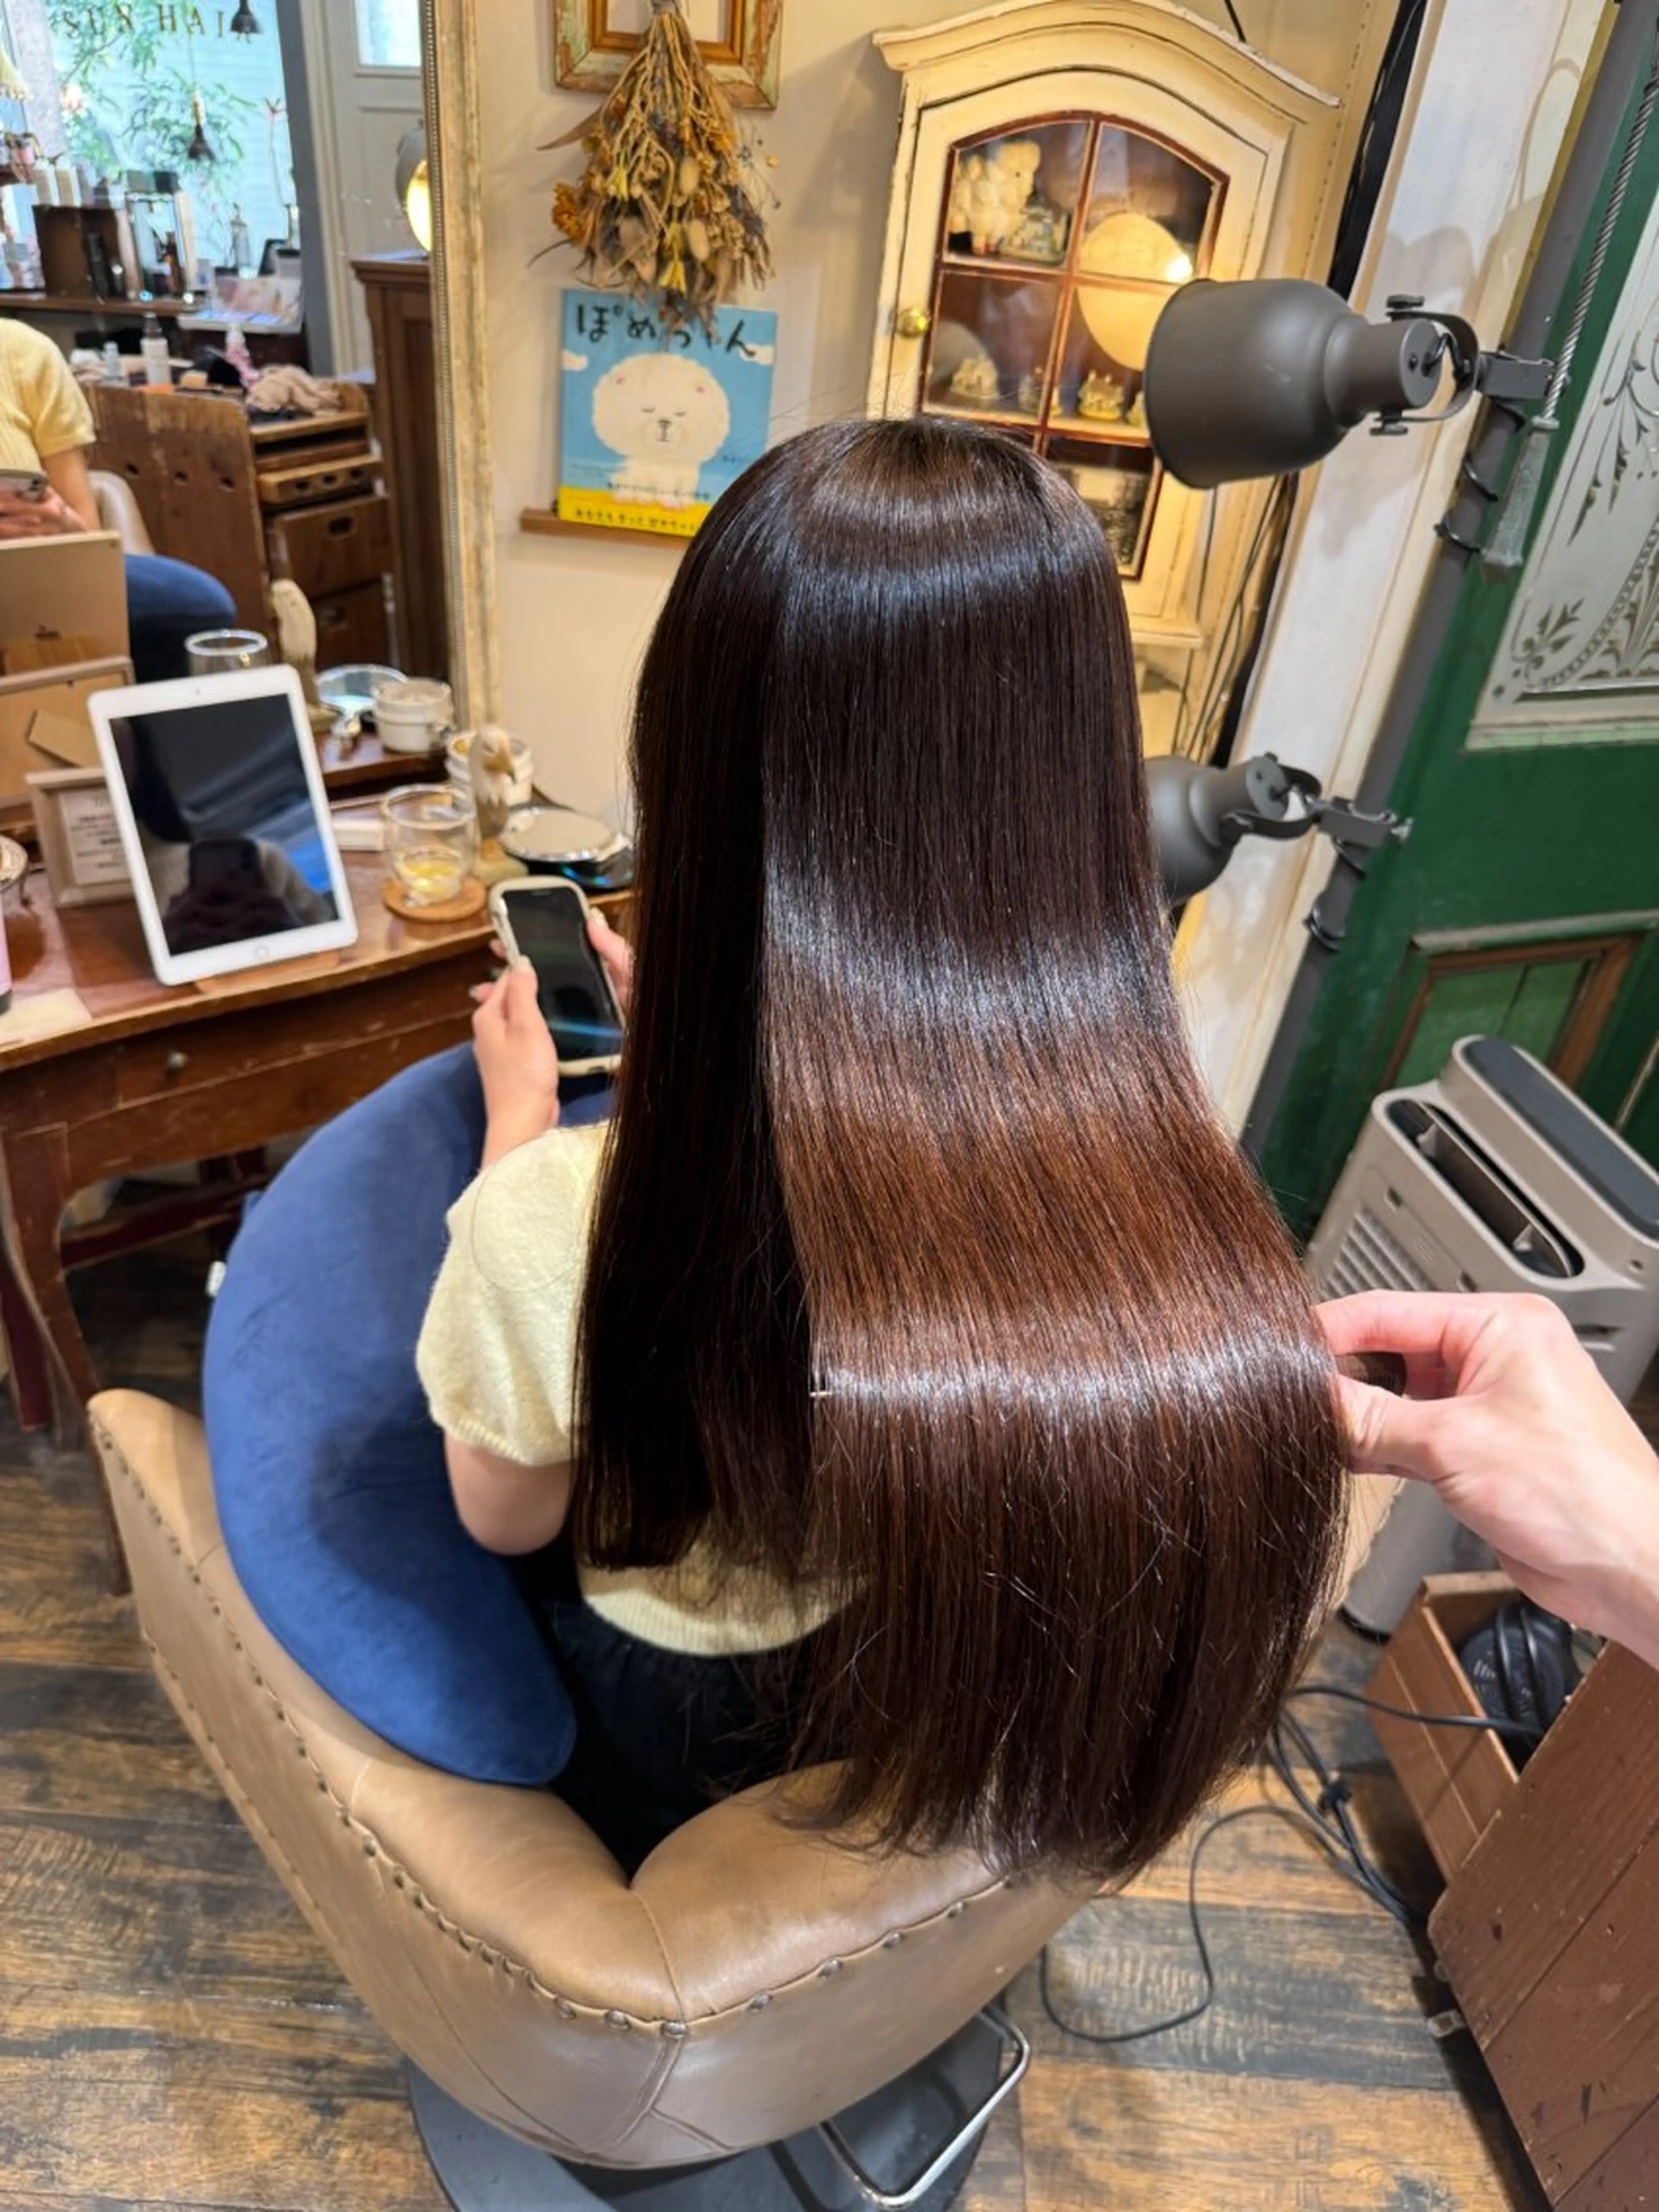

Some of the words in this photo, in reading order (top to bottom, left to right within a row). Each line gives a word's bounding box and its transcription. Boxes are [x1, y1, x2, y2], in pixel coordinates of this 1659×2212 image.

[157, 3, 252, 42] HAI
[577, 304, 756, 357] ぽめん
